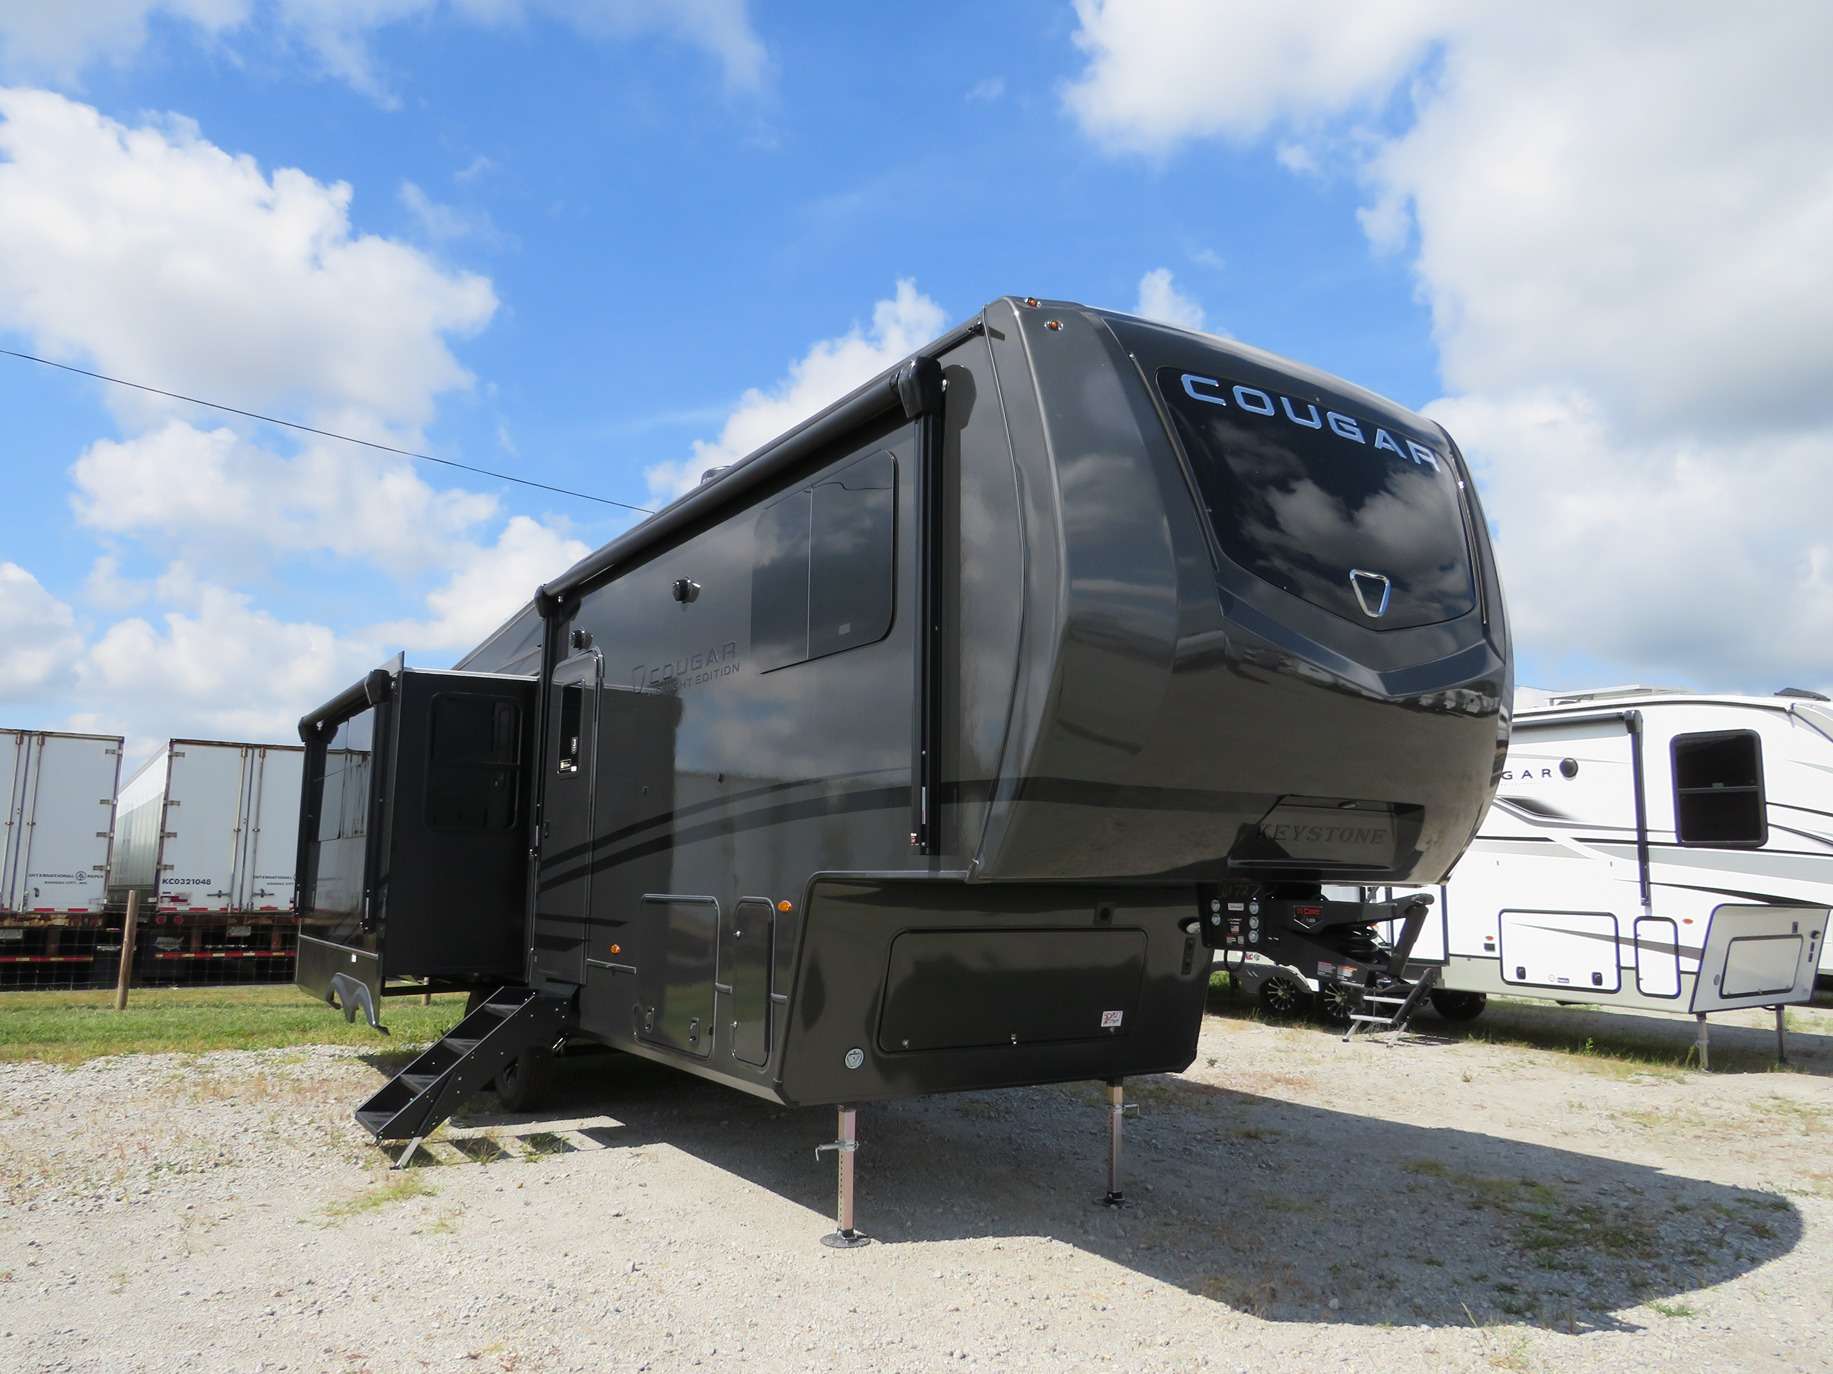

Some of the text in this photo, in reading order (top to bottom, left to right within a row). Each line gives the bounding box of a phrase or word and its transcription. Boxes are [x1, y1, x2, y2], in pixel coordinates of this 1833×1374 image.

[1180, 373, 1441, 473] COUGAR
[649, 641, 738, 684] COUGAR
[696, 663, 740, 685] EDITION
[1501, 768, 1552, 780] GAR
[1256, 823, 1387, 845] KEYSTONE
